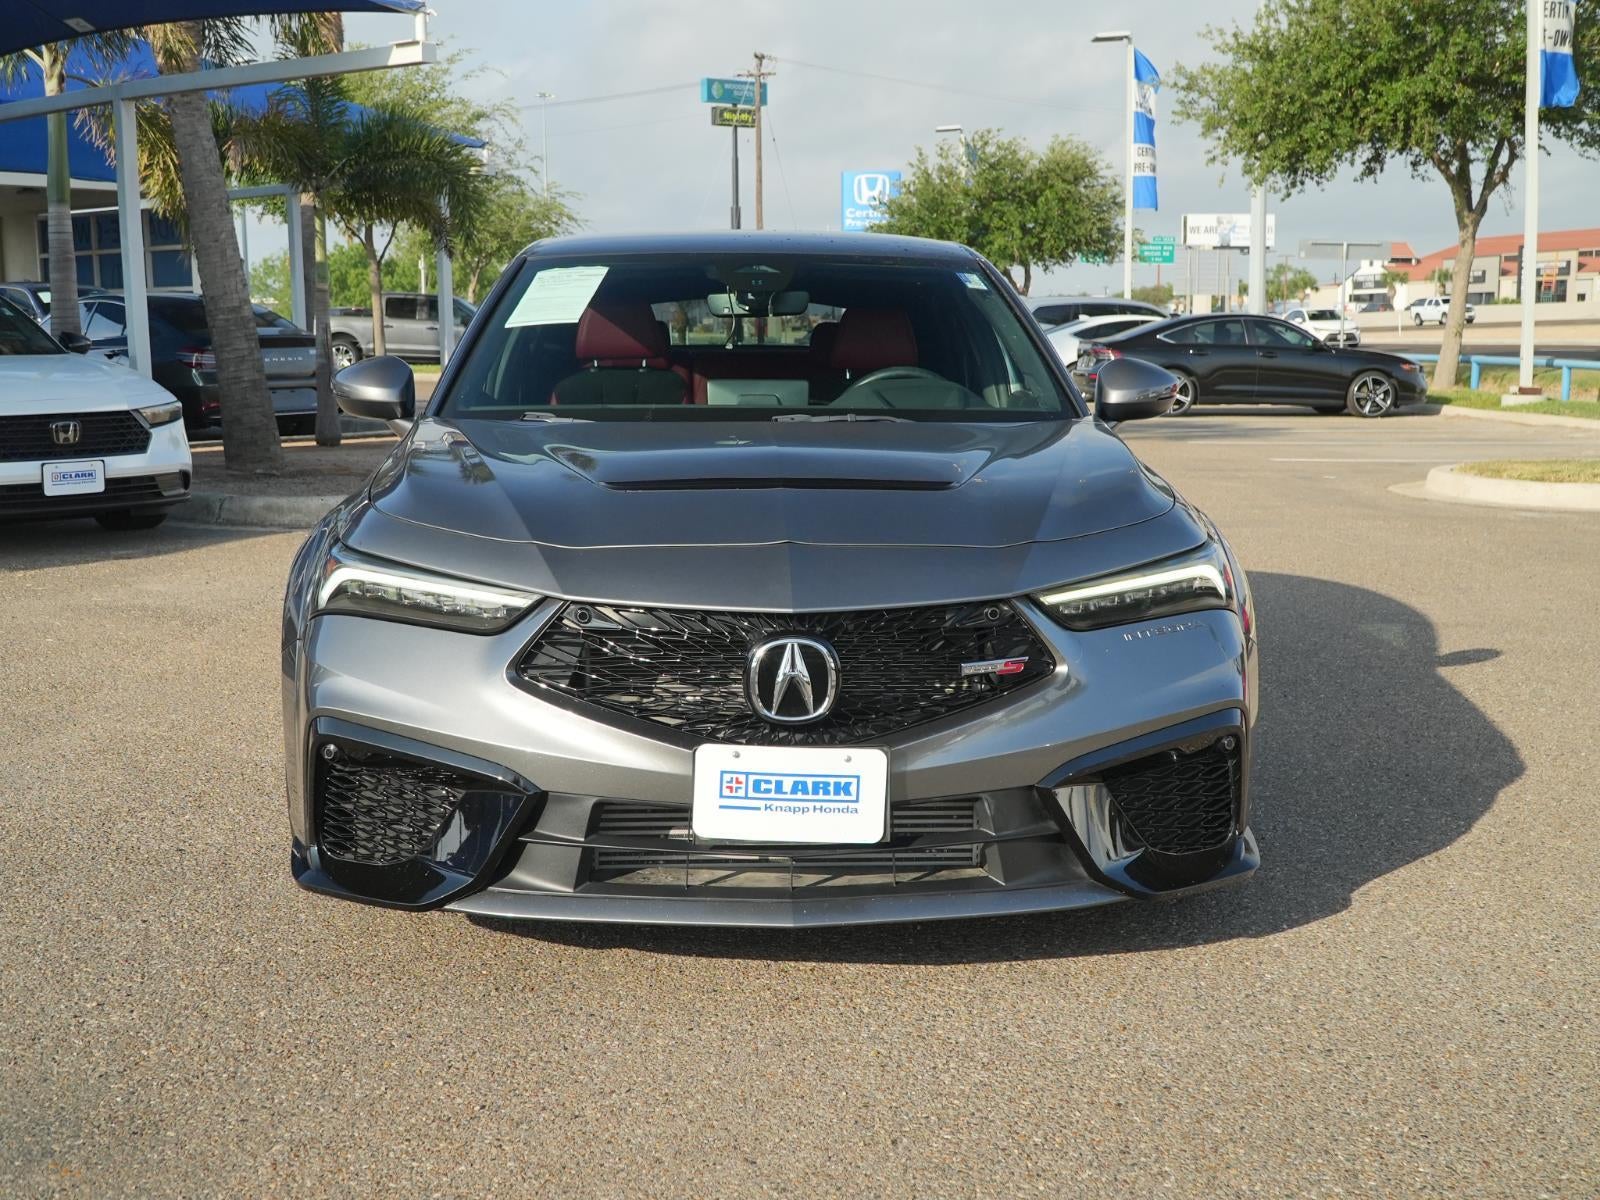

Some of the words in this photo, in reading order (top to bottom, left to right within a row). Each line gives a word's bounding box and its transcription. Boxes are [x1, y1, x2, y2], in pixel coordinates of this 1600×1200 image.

[1189, 225, 1201, 234] WE
[264, 355, 304, 363] ENESIS
[62, 472, 94, 480] CLARK
[752, 778, 854, 797] CLARK
[764, 803, 810, 815] Knapp
[812, 805, 859, 815] Honda
